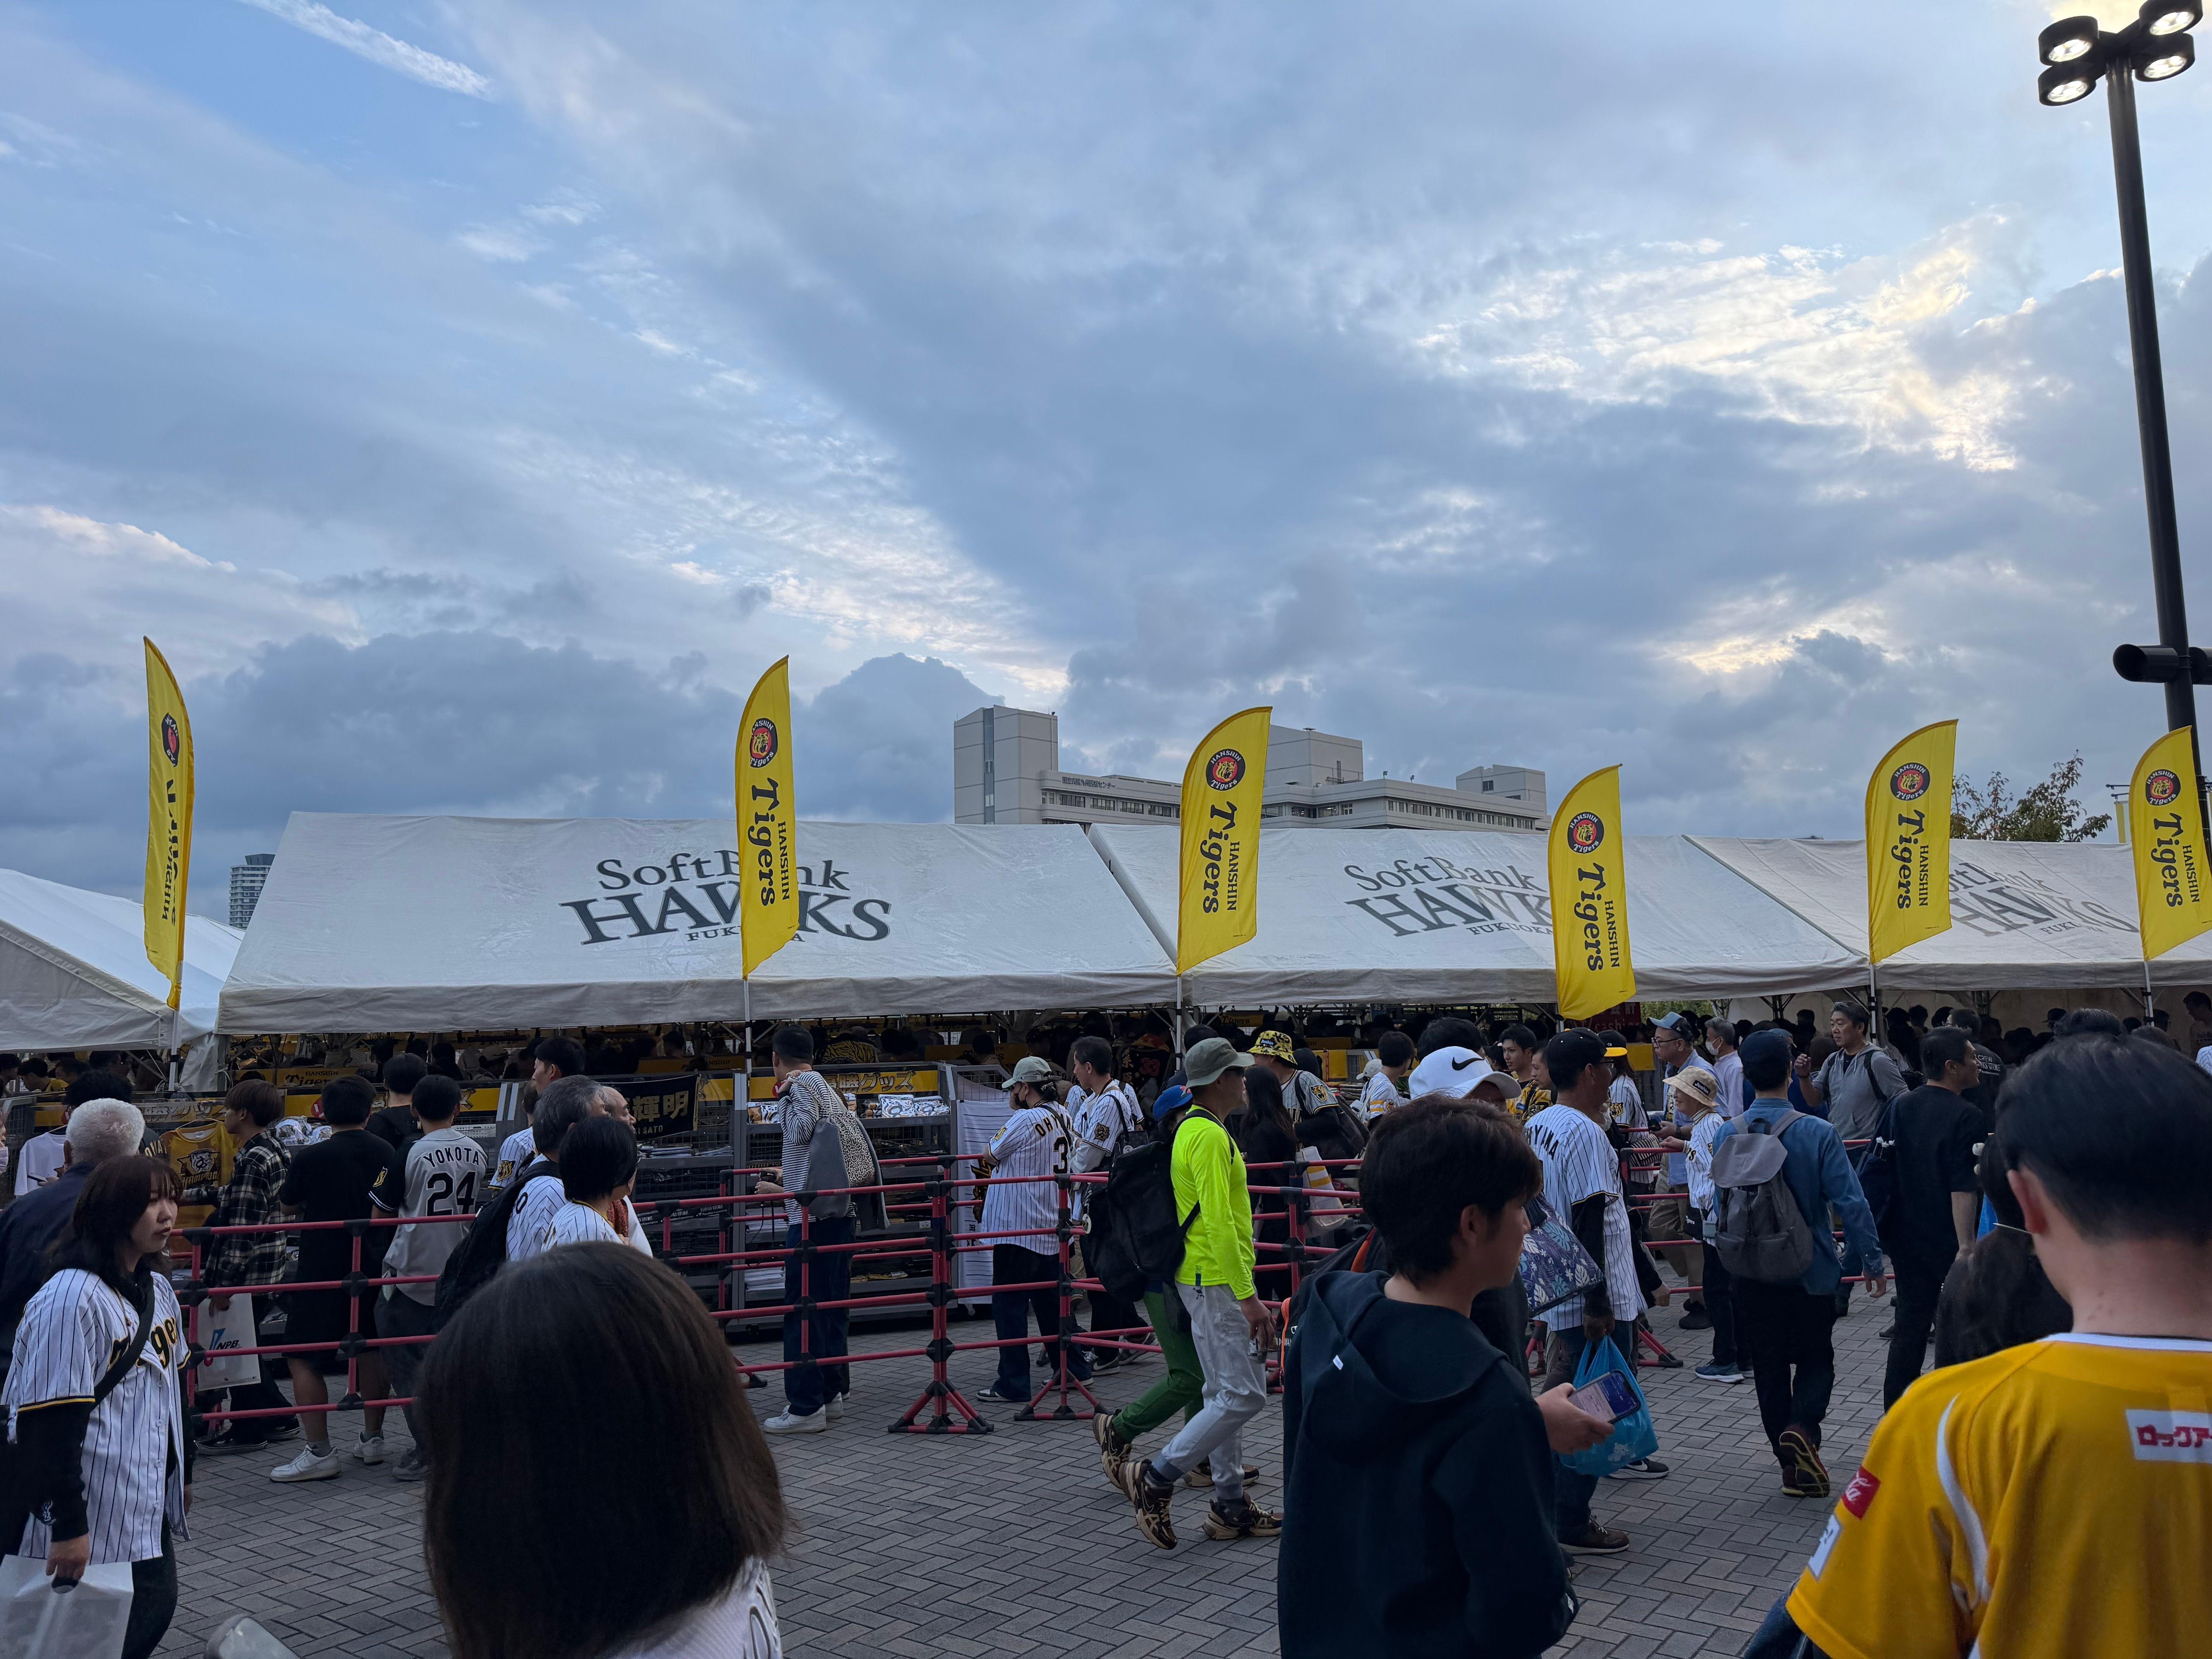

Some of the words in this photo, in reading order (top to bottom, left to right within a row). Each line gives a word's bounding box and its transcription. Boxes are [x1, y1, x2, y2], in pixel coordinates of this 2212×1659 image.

[752, 720, 773, 735] NSHIN
[750, 751, 774, 767] Tigers
[1211, 750, 1241, 764] HANSHIN
[1894, 764, 1926, 777] HANSHIN
[2147, 771, 2174, 784] HANSHIN
[1211, 779, 1238, 790] Tigers
[1896, 789, 1924, 800] Tigers
[2150, 793, 2176, 805] Tigers
[1570, 814, 1598, 828] HANSHIN
[748, 778, 780, 907] Tigers
[1573, 840, 1599, 853] Tigers
[778, 821, 790, 900] HANSHIN
[1200, 801, 1238, 914] Tigers
[1891, 809, 1925, 909] Tigers
[2151, 813, 2183, 907] Tigers
[597, 850, 851, 891] SoftBnk
[1227, 842, 1240, 911] HANSHIN
[1344, 856, 1548, 892] SoftBank
[1918, 845, 1929, 906] HANSHIN
[1949, 862, 2064, 895] ftBank
[2182, 845, 2200, 903] HANSHIN
[1344, 883, 1553, 937] HAWK
[1574, 862, 1606, 971] Tigers
[687, 925, 805, 943] FUKA
[1604, 900, 1620, 967] HANSHIN
[285, 1074, 328, 1085] Tiger
[1694, 1082, 1709, 1095] Joshin
[629, 1090, 689, 1122] 輝明
[642, 1125, 663, 1134] SATO
[422, 1146, 479, 1168] YOKOTA
[426, 1171, 476, 1216] 24
[216, 1340, 239, 1350] NPB
[2135, 1424, 2212, 1448] ロックア
